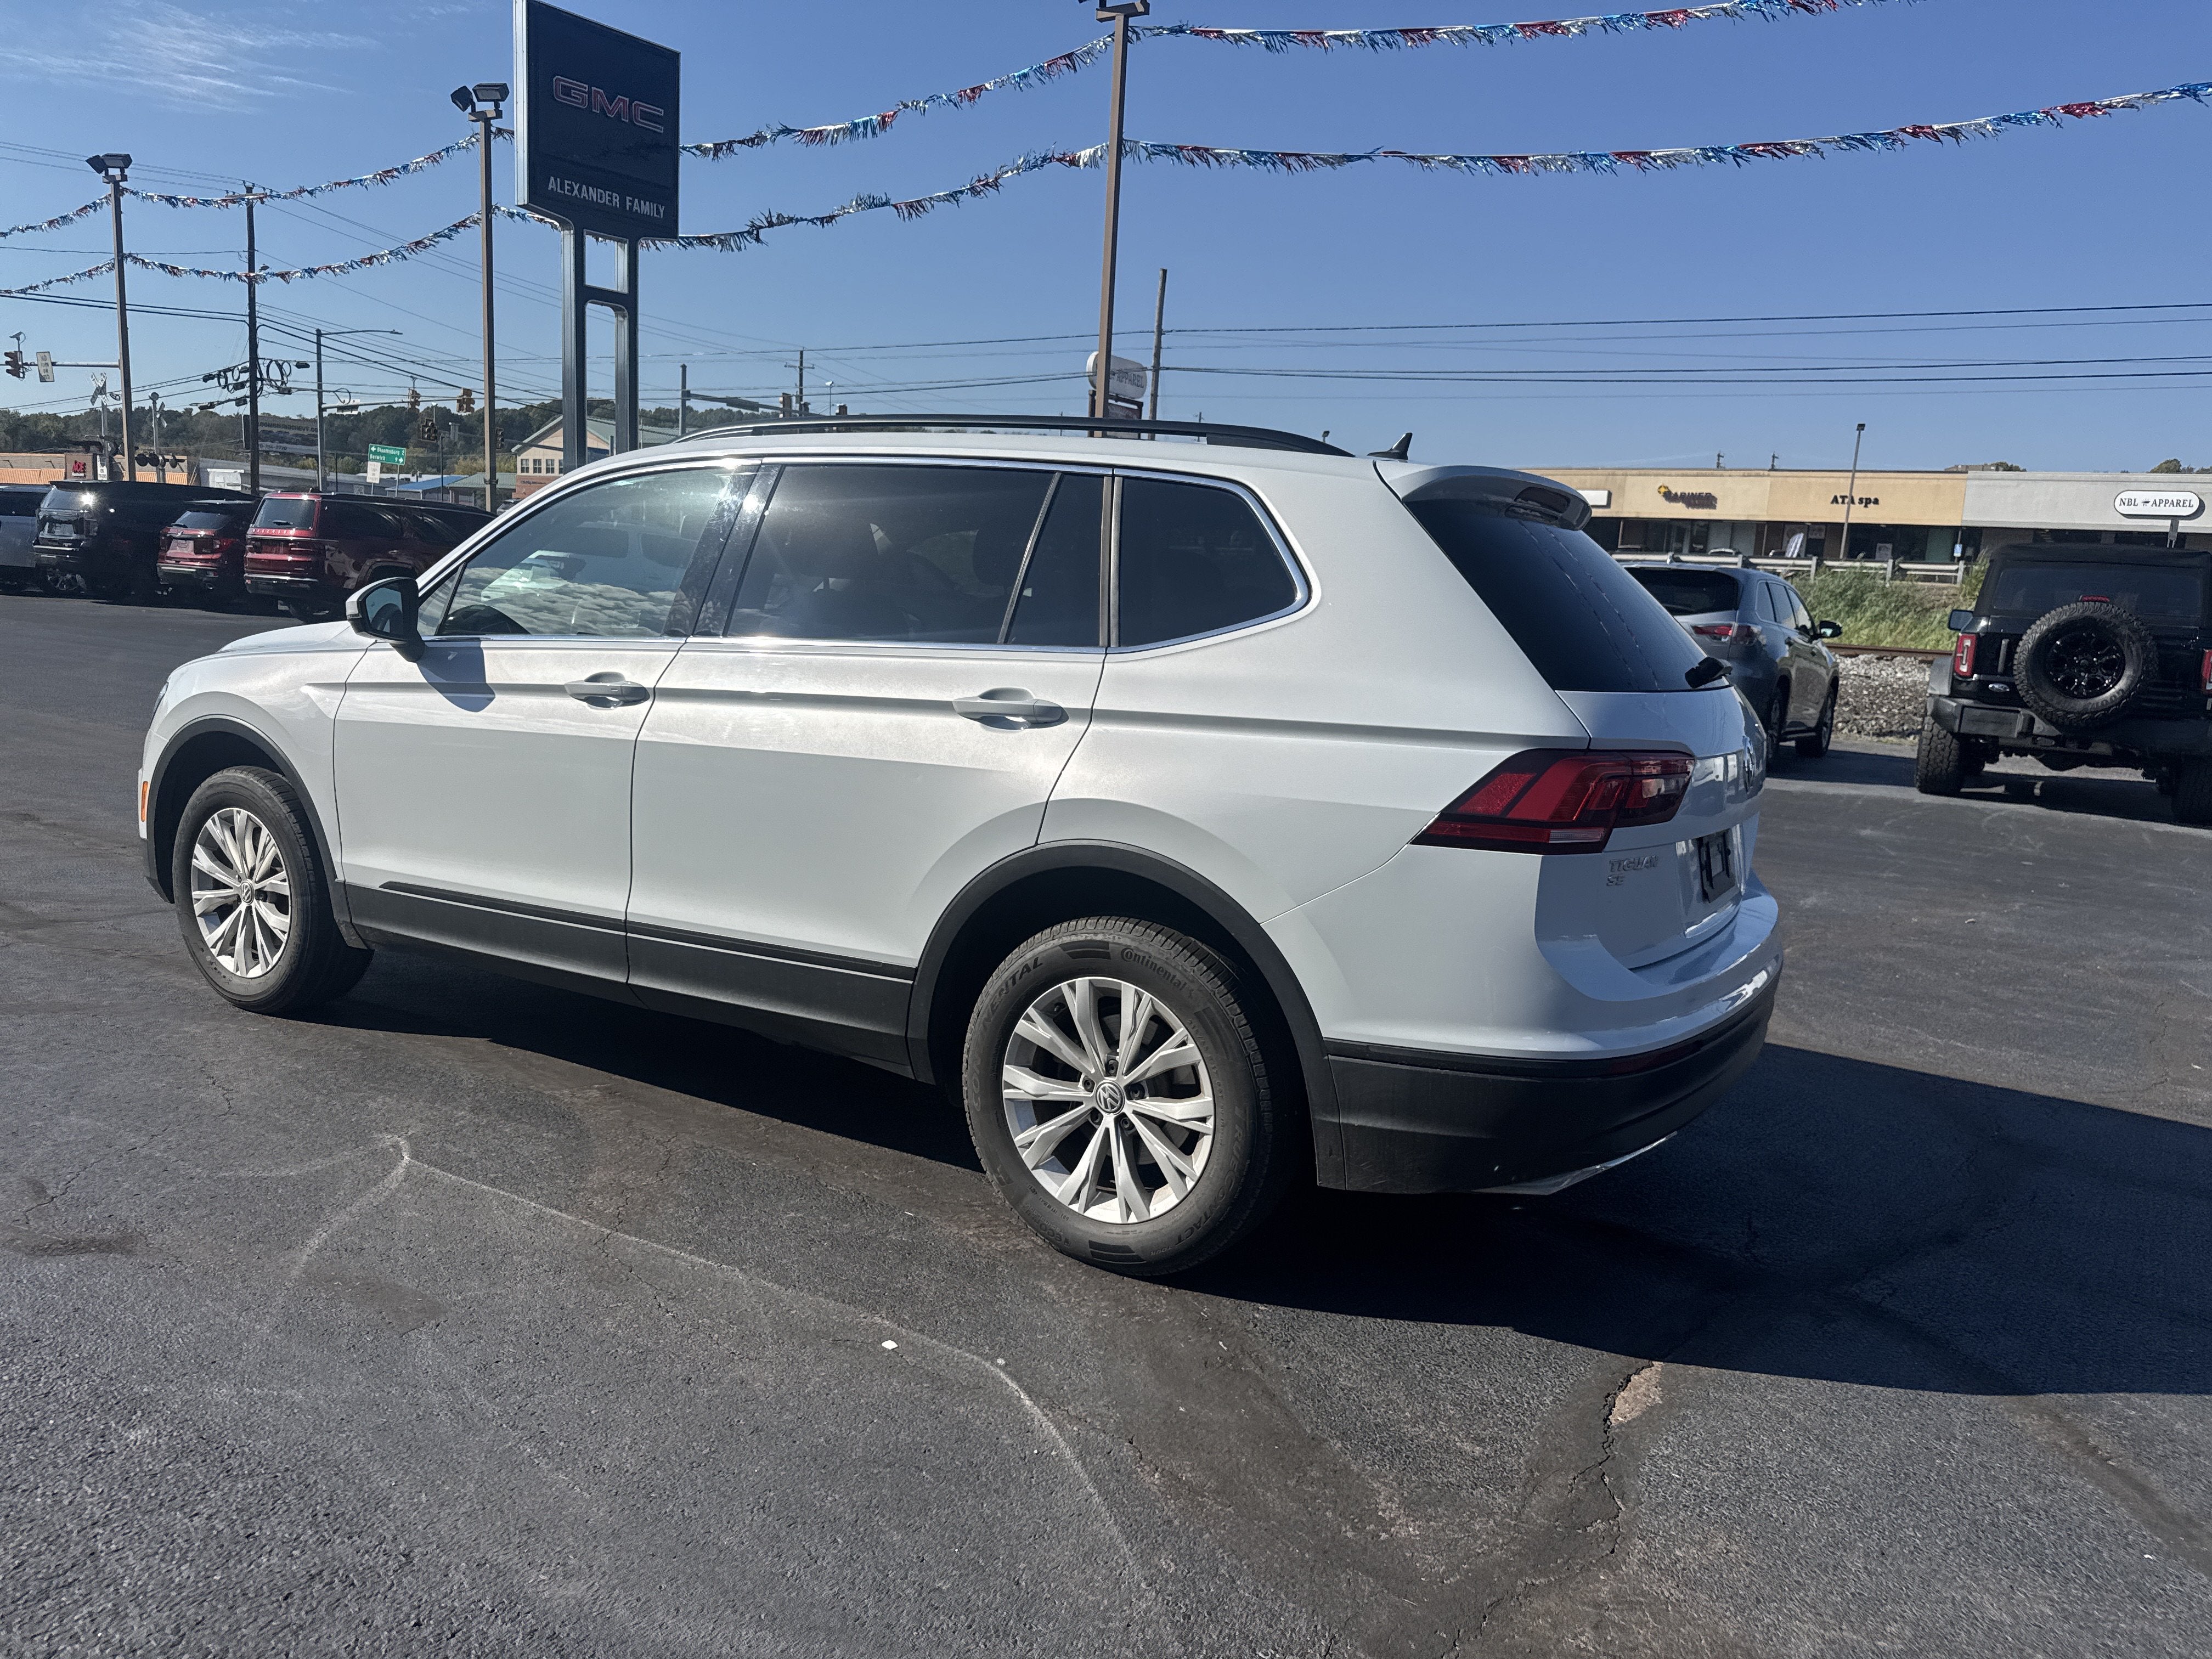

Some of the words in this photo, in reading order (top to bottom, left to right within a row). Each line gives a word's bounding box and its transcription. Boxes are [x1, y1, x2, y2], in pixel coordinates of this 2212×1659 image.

[552, 75, 664, 133] GMC
[548, 176, 620, 208] ALEXANDER
[625, 196, 665, 219] FAMILY
[1858, 497, 1880, 509] spa
[2119, 498, 2138, 507] NBL
[2151, 499, 2194, 508] APPAREL
[1120, 947, 1188, 990] Continental
